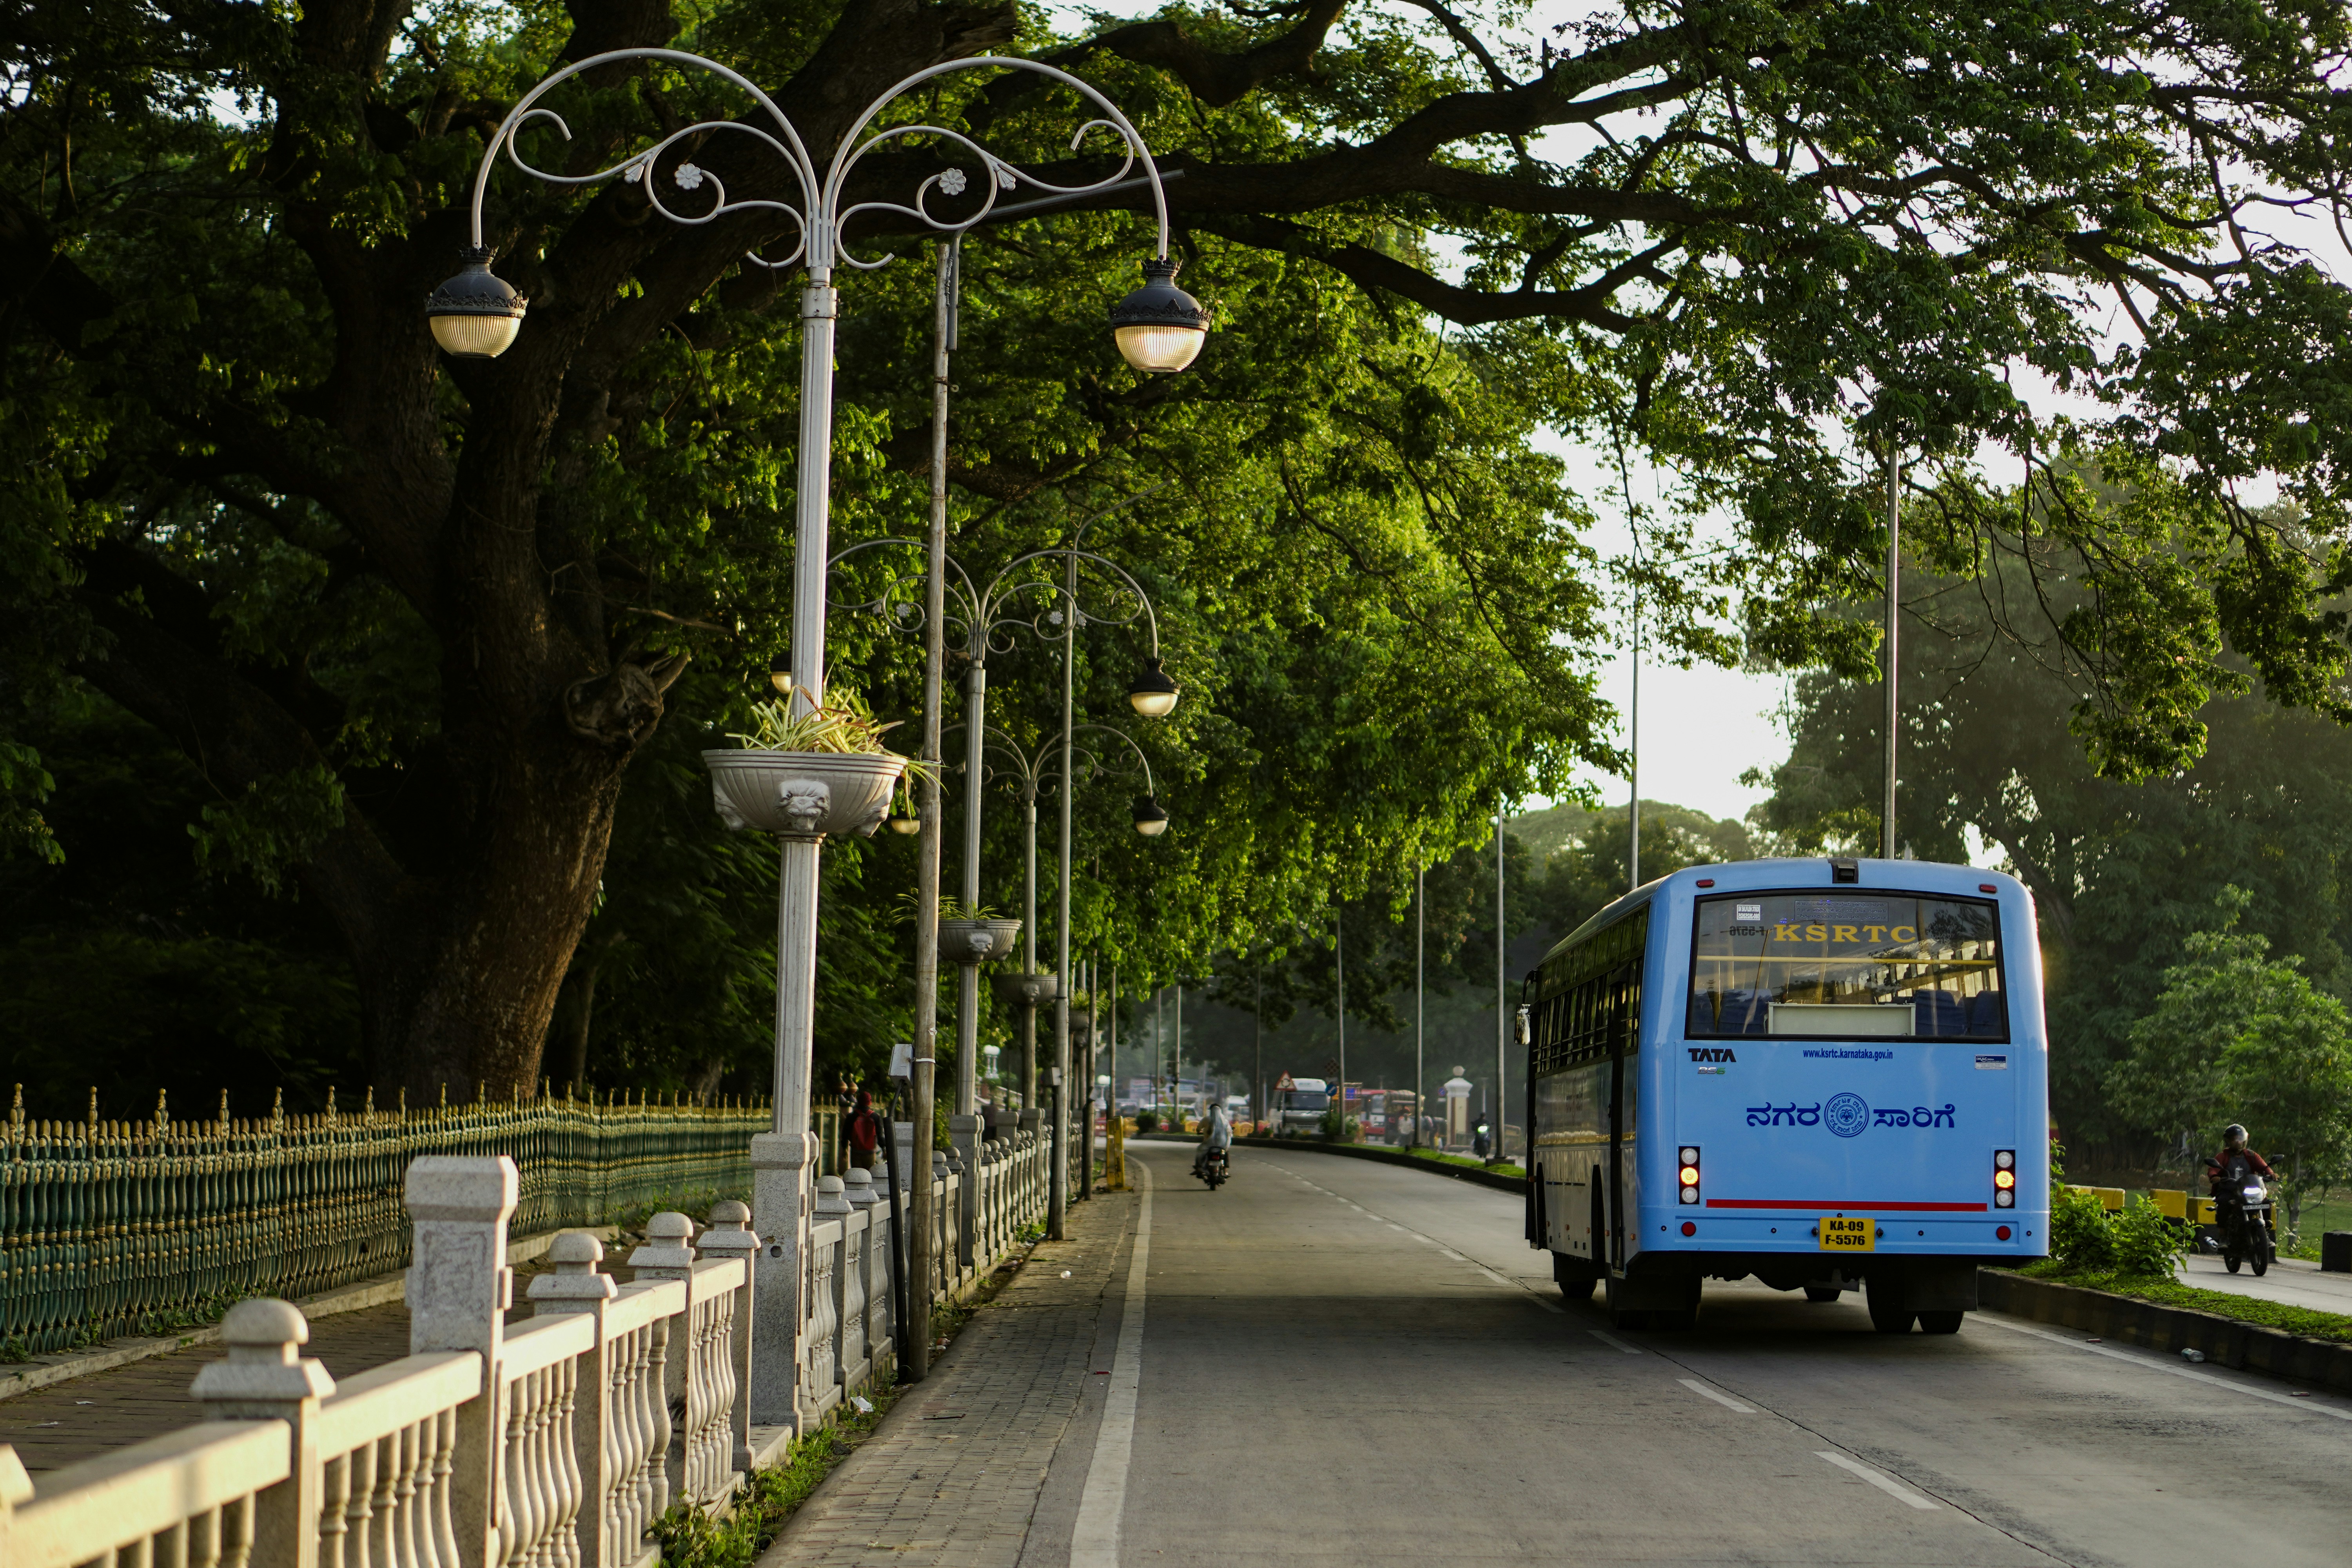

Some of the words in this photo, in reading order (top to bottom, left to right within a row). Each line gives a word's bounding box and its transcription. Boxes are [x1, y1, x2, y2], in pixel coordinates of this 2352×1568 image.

[1774, 925, 1915, 942] KSRTC
[1688, 1048, 1737, 1062] TATA
[1803, 1047, 1893, 1061] www.ksrtc.karnataka.gov.in
[1830, 1098, 1851, 1113] ಕರ್ನಾಟಕ
[1853, 1101, 1863, 1114] ರಾಜ್ಯ
[1746, 1102, 1820, 1127] ನಗರ
[1873, 1103, 1955, 1128] ಸಾರಿಗೆ
[1830, 1118, 1838, 1129] ರಸ್ತೆ
[1851, 1120, 1863, 1132] ನಿಗಮ
[1829, 1220, 1864, 1232] KA-09
[1825, 1234, 1866, 1245] F-5576
